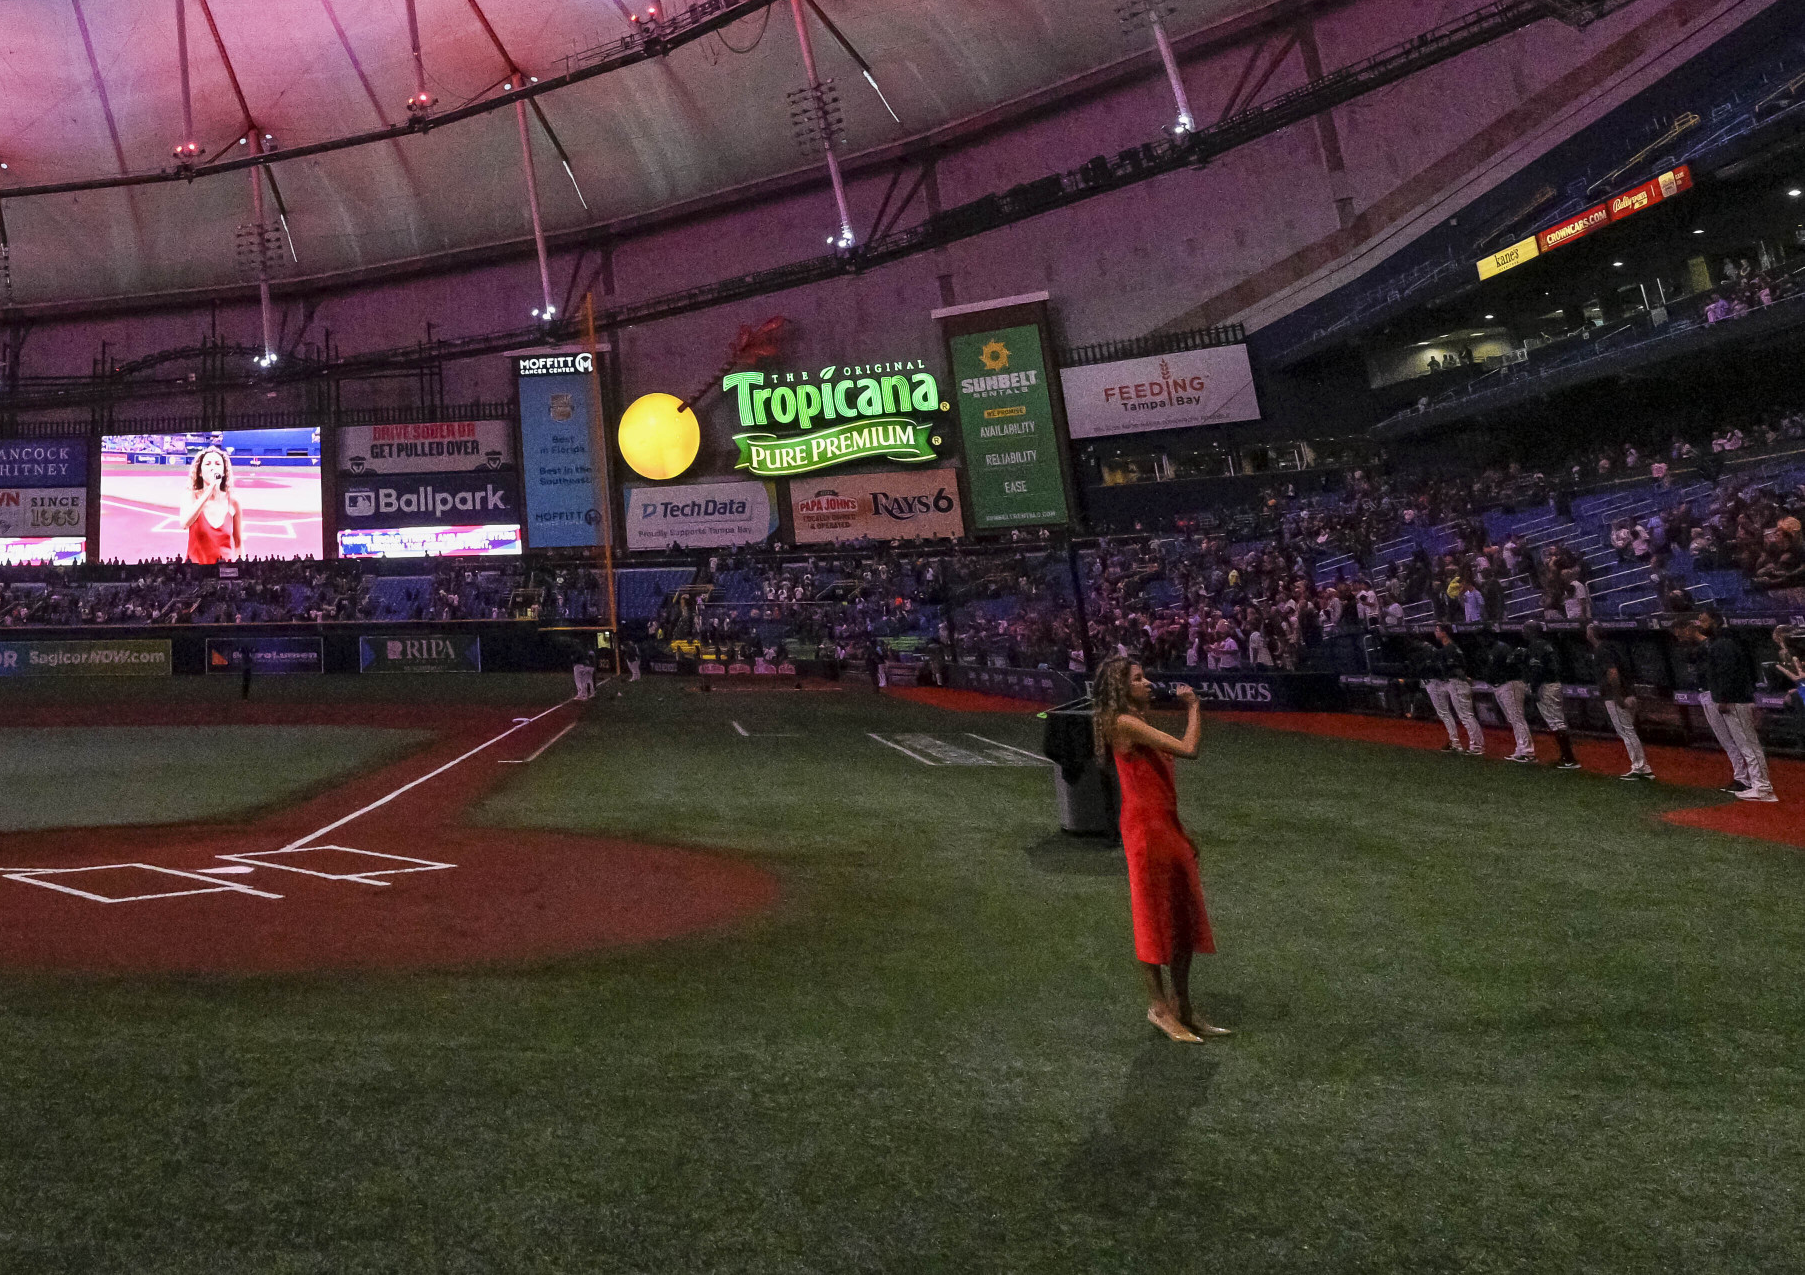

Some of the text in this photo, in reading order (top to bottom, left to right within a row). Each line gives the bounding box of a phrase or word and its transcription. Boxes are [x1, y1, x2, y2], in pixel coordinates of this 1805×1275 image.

[1546, 209, 1607, 245] CROWNCARS.COM
[519, 357, 574, 370] MOFFITT
[520, 368, 547, 376] CANCER
[771, 359, 925, 383] THE ORIGINAL
[960, 370, 1038, 393] SUNBELT
[973, 386, 1029, 398] RENTALS
[1104, 376, 1205, 406] FEEDING
[723, 371, 939, 429] Tropicana
[1122, 395, 1202, 412] Tampa Bay
[980, 420, 1036, 438] AVAILABILITY
[370, 439, 480, 460] GET PULLED OVER
[750, 424, 915, 469] PURE PREMIUM
[985, 449, 1037, 466] RELIABILITY
[1004, 480, 1028, 494] EASE
[30, 496, 80, 508] SINCE
[378, 484, 506, 518] Ballpark
[660, 498, 747, 519] Tech Data
[799, 499, 822, 513] PAPA
[933, 487, 954, 514] 6
[30, 509, 81, 528] 1969
[535, 511, 584, 522] MOFFITT
[405, 639, 456, 660] RIPA
[1197, 681, 1273, 703] JAMES
